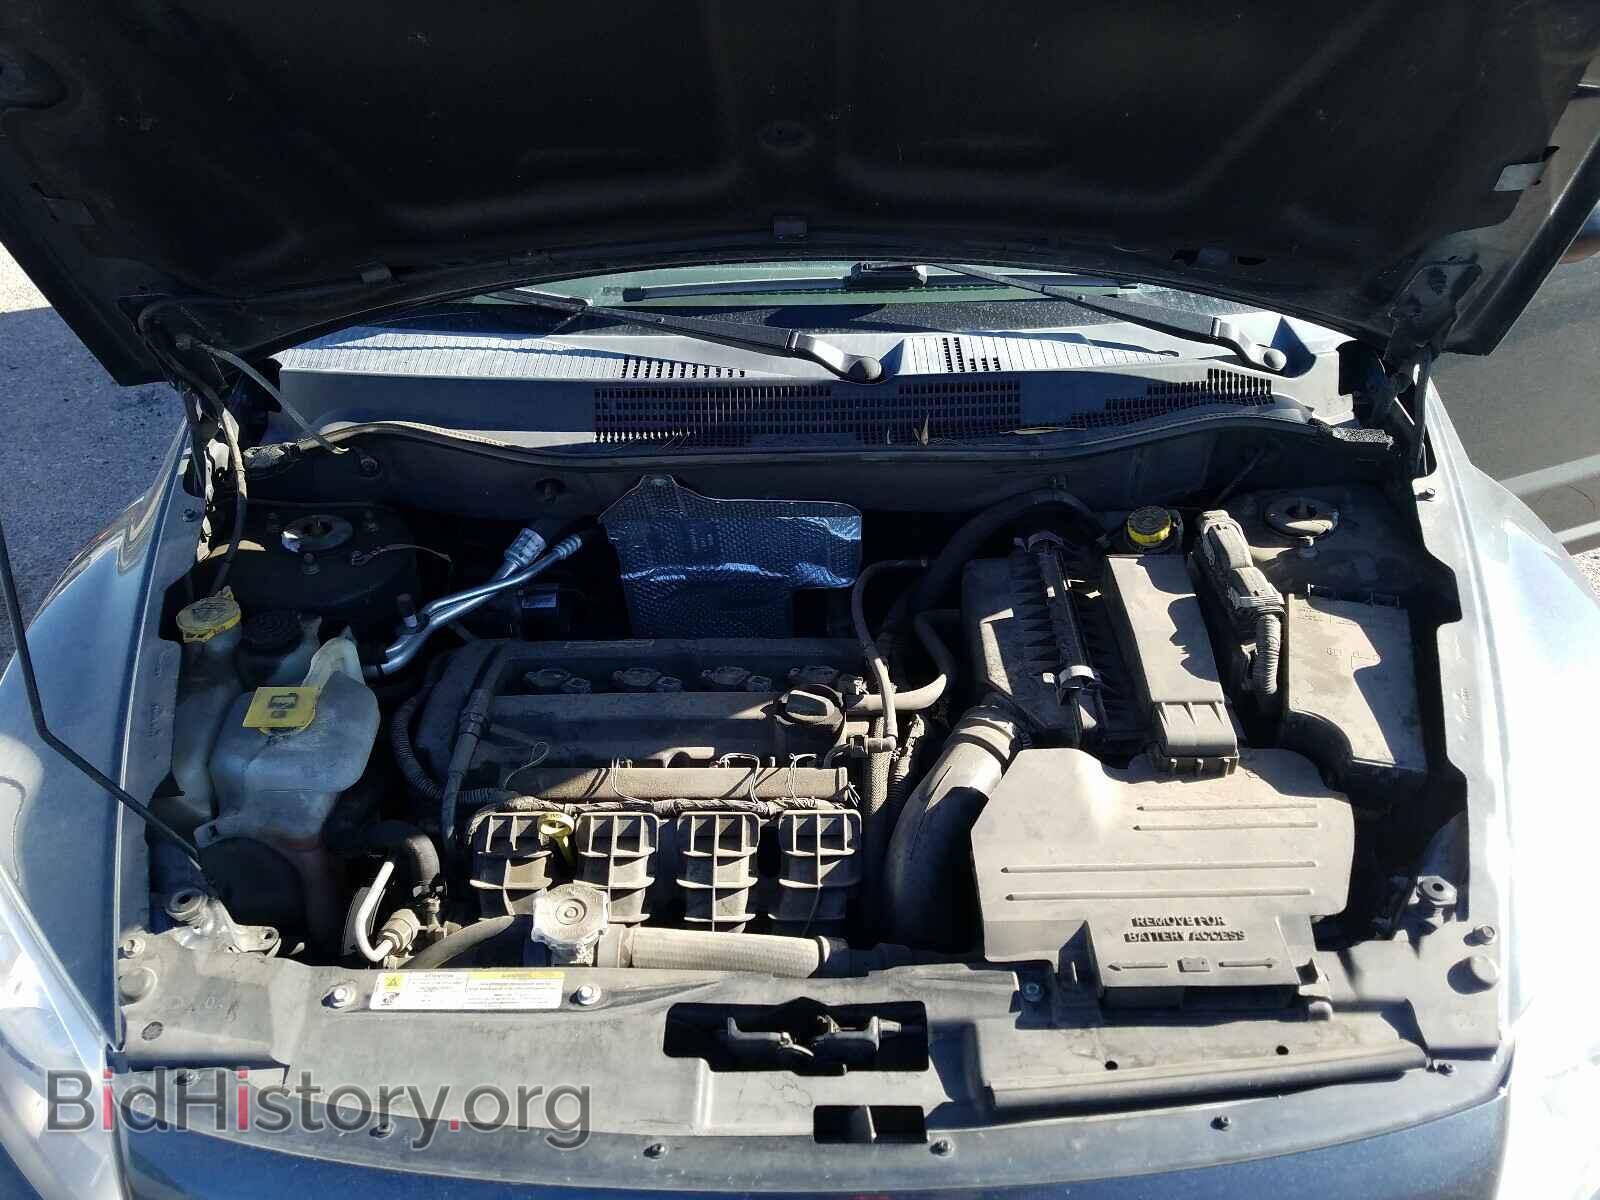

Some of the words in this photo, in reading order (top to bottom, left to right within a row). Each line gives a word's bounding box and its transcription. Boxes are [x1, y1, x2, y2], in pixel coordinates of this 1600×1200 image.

[1132, 916, 1193, 928] REMOVE
[1195, 915, 1225, 927] FOR
[1188, 930, 1246, 942] ACCESS
